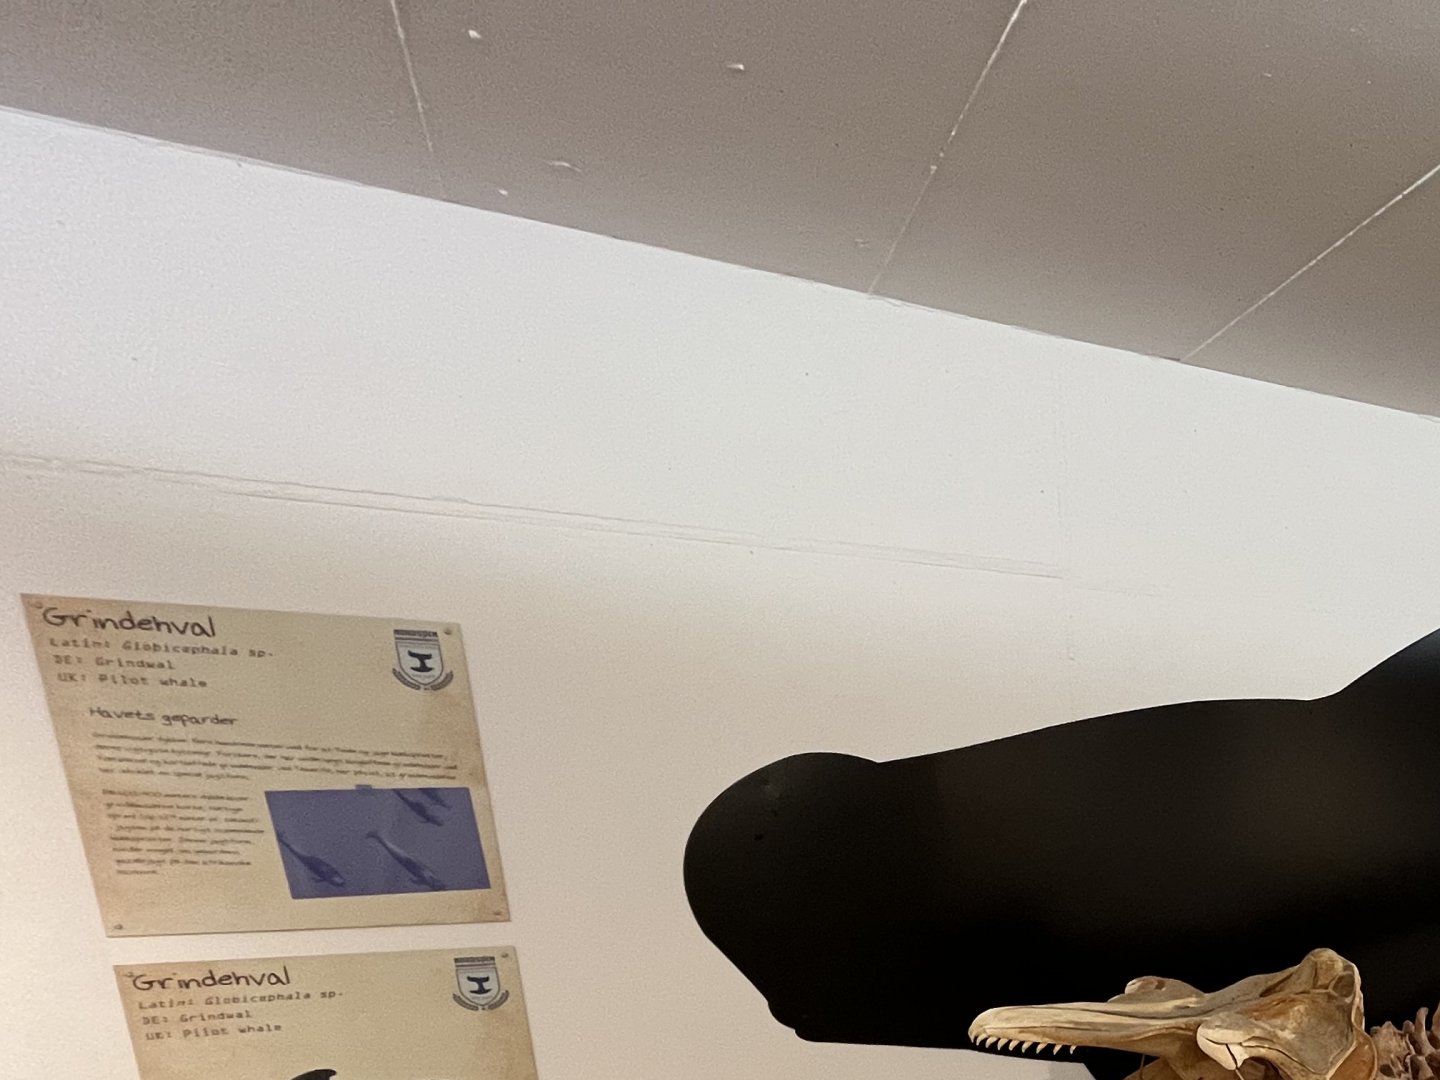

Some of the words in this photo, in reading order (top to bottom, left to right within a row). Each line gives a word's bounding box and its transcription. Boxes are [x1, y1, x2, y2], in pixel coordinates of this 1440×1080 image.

[42, 607, 216, 638] Grindehval
[49, 637, 110, 649] Latin:
[122, 640, 238, 656] Globicephala
[95, 656, 176, 670] Grindwal
[98, 674, 150, 686] Pilot
[158, 678, 207, 688] whale
[89, 706, 155, 722] Havets
[162, 713, 238, 727] geparder
[131, 965, 291, 991] Grindehval
[138, 999, 194, 1011] Latin:
[204, 990, 311, 1006] Globicephala
[180, 1009, 252, 1024] Grindwal
[182, 1027, 230, 1039] Pilot
[238, 1023, 282, 1034] whale
